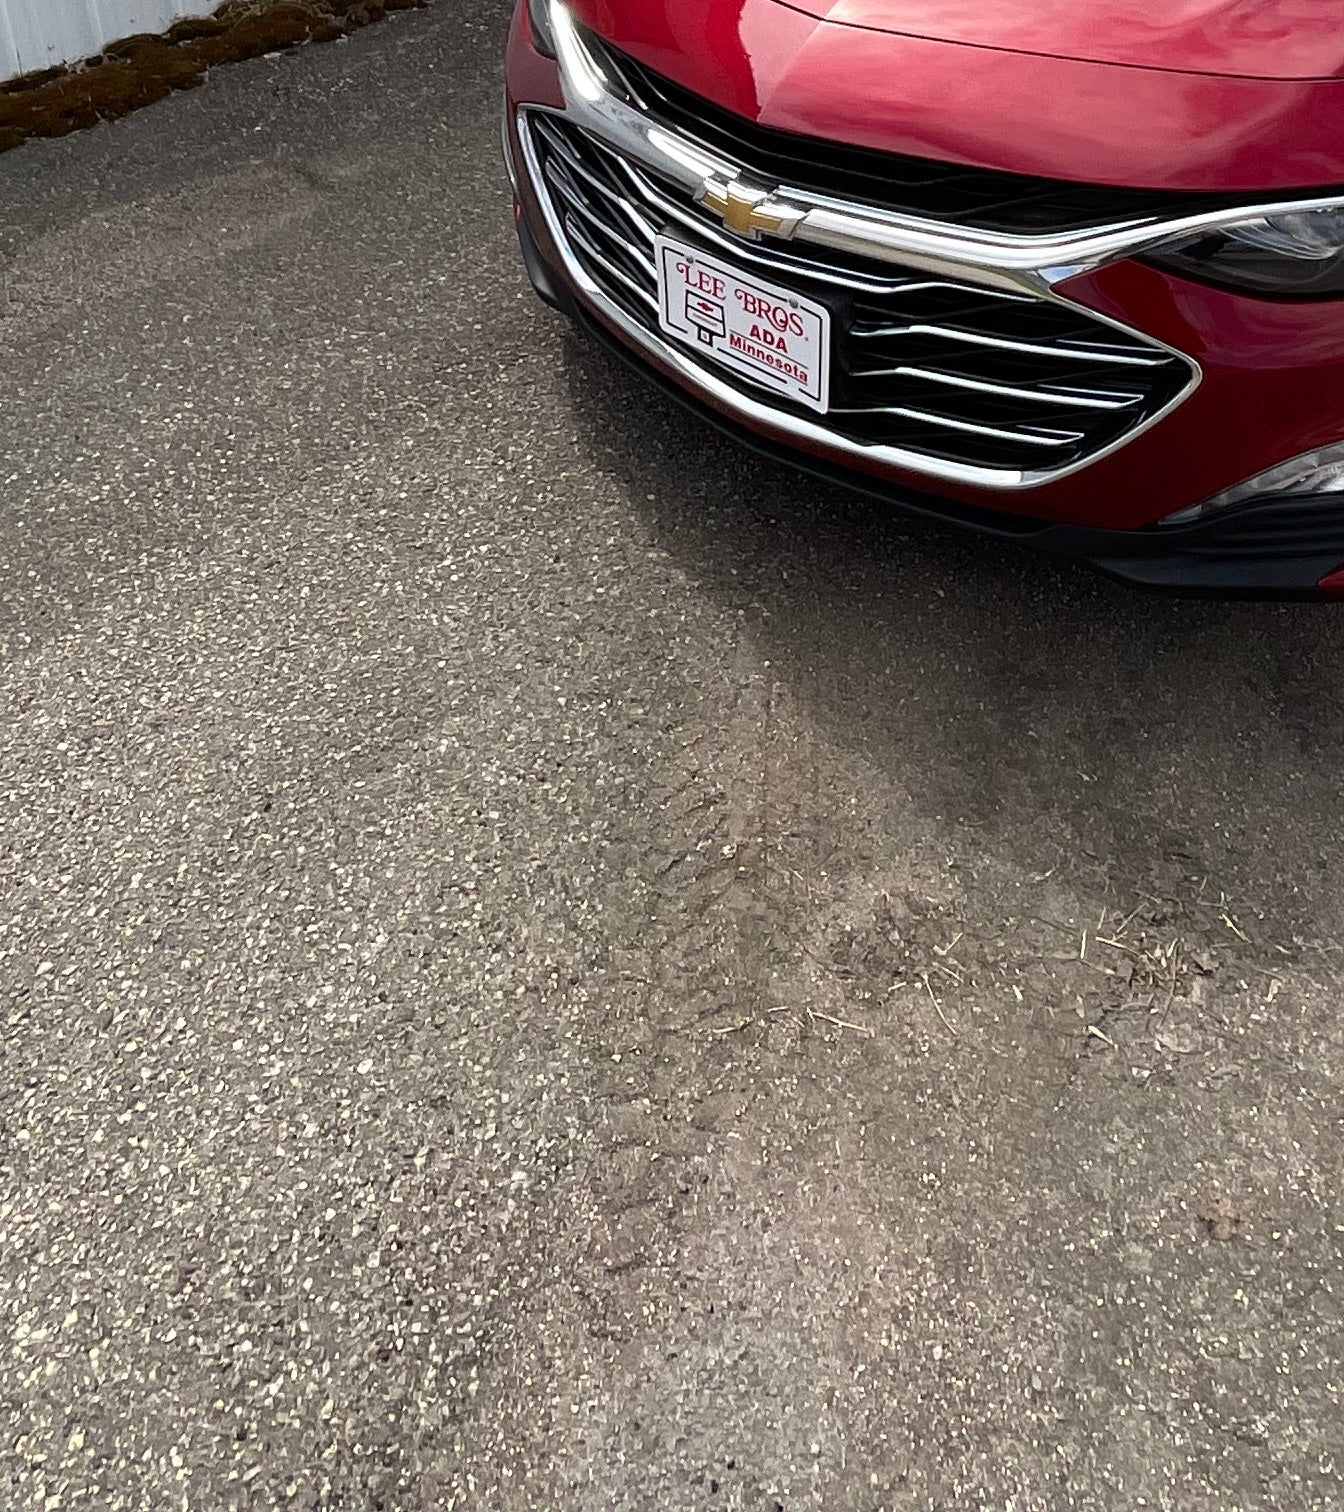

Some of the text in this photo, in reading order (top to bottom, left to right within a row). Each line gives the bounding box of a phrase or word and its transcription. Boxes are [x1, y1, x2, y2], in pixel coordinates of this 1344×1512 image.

[676, 262, 727, 301] LEE
[729, 333, 808, 382] Minnesota
[750, 324, 788, 353] ADA
